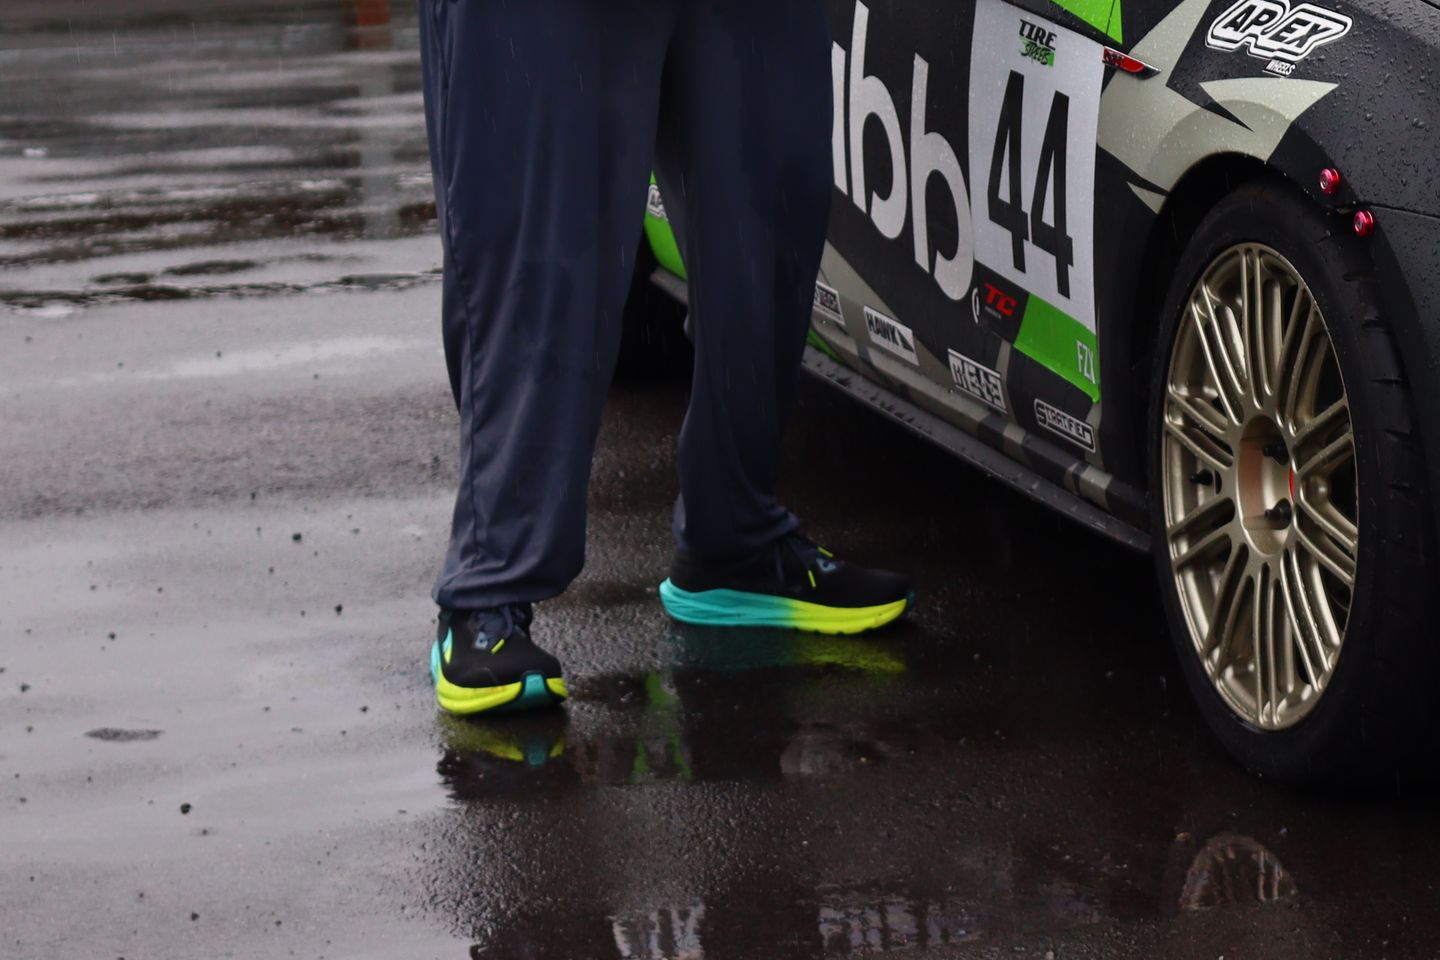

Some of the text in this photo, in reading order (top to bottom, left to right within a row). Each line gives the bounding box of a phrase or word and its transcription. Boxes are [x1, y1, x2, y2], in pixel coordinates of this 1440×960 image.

[1018, 18, 1058, 51] TIRE
[1221, 5, 1330, 48] APEX
[987, 69, 1074, 300] 44
[983, 283, 1018, 317] TC
